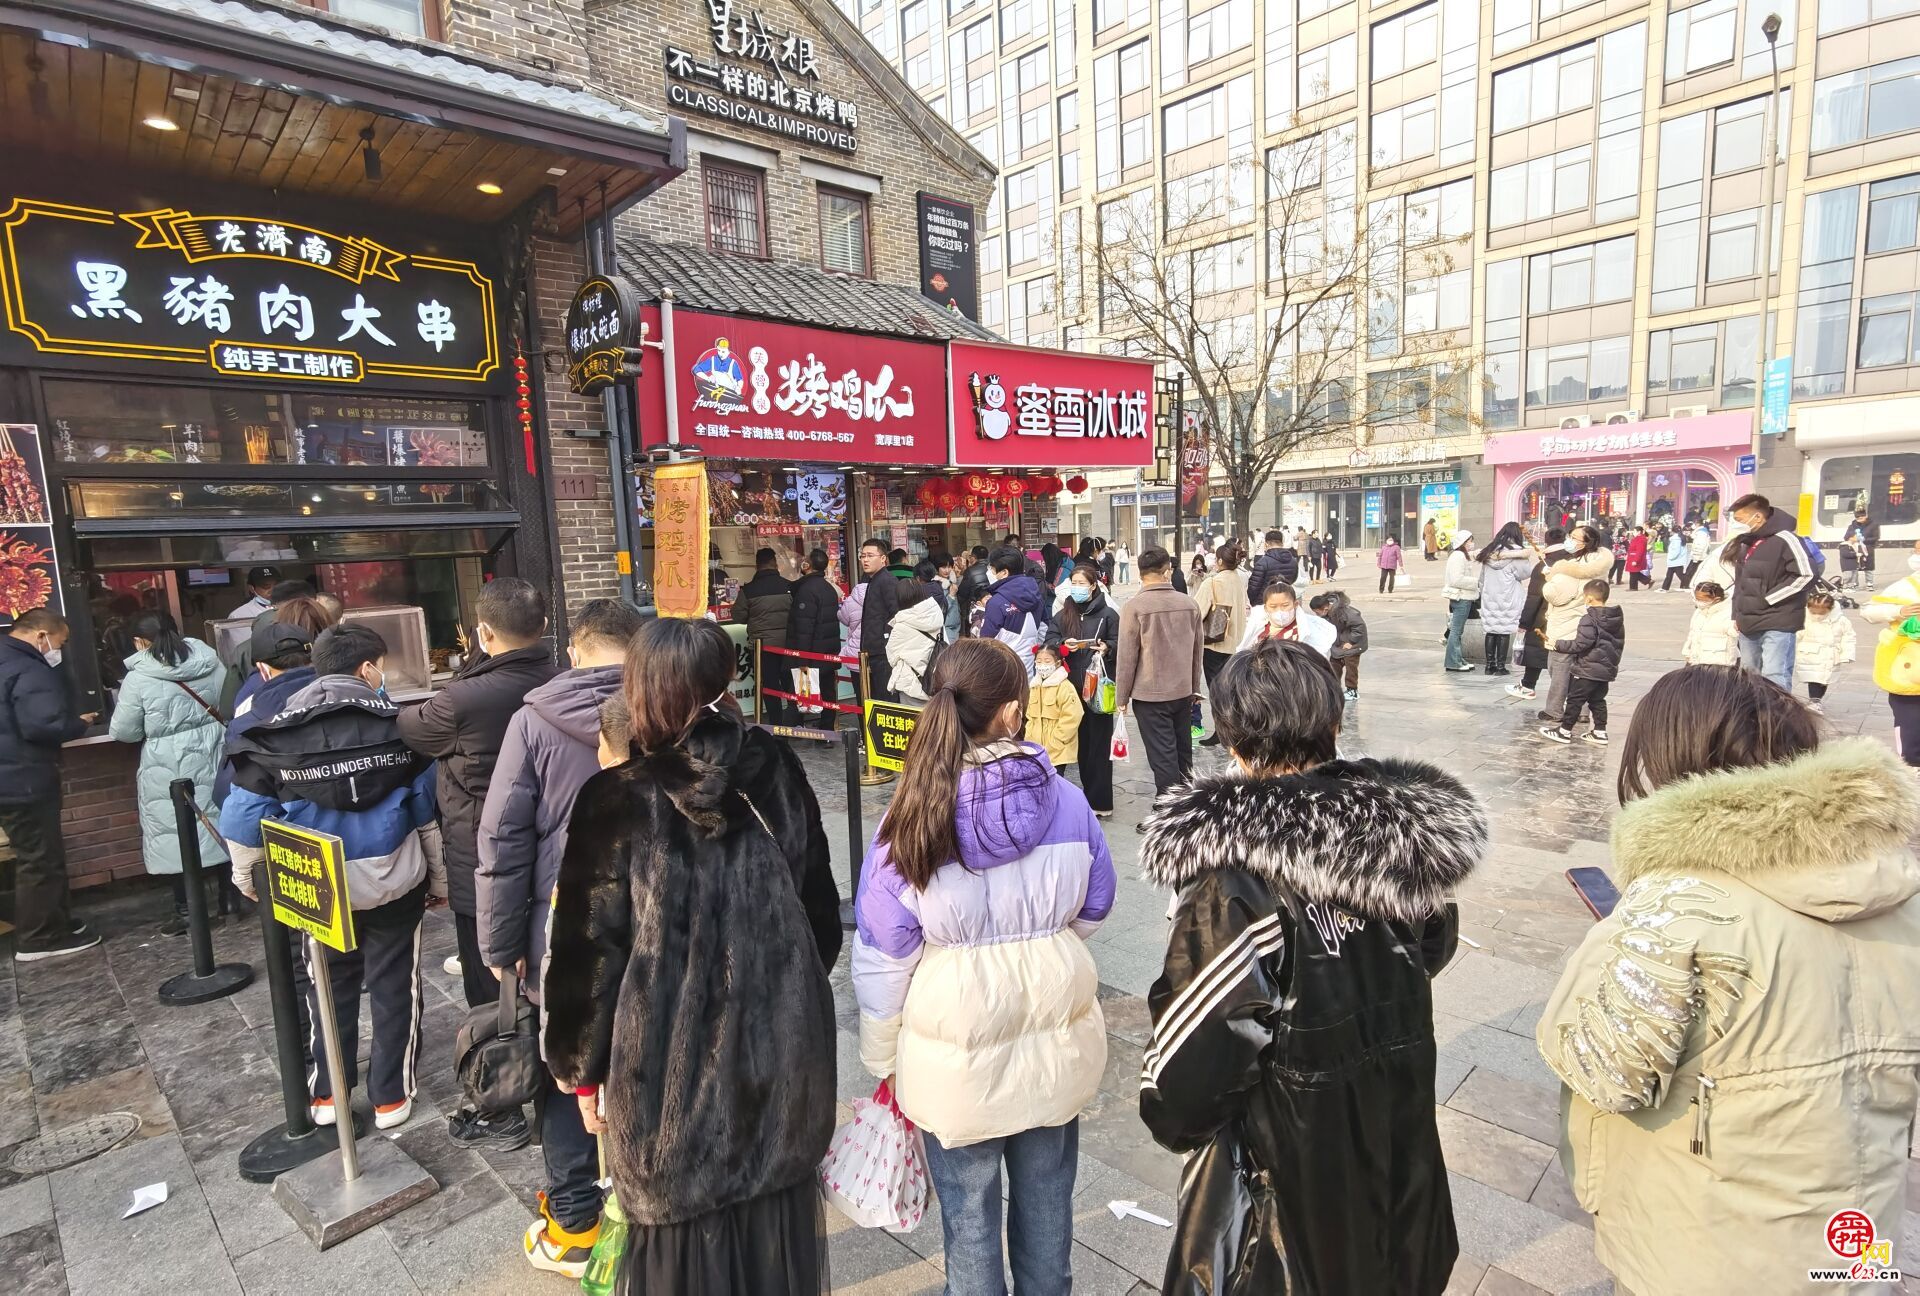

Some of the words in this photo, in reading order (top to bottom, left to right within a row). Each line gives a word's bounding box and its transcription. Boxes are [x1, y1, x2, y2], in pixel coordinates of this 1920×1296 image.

[669, 47, 857, 128] 不一样的北京烤鸭
[671, 85, 858, 151] CLASSICAL&IMPROVED
[216, 221, 332, 266] 老濟南
[70, 260, 456, 352] 黑豬肉大串
[224, 346, 354, 378] 纯手工制作
[774, 353, 914, 422] 烤鸡爪
[695, 423, 785, 440] 全国统一咨询热线
[787, 430, 855, 443] 400-6768-567
[1016, 383, 1148, 439] 蜜雪冰城
[561, 479, 585, 494] 111
[656, 497, 689, 588] 烤鸡爪
[280, 765, 330, 781] NOTHING
[332, 757, 373, 776] UNDER
[372, 753, 395, 768] THE
[395, 750, 413, 765] HAT
[268, 842, 322, 880] 网红猪肉大串
[277, 872, 321, 911] 在此排队
